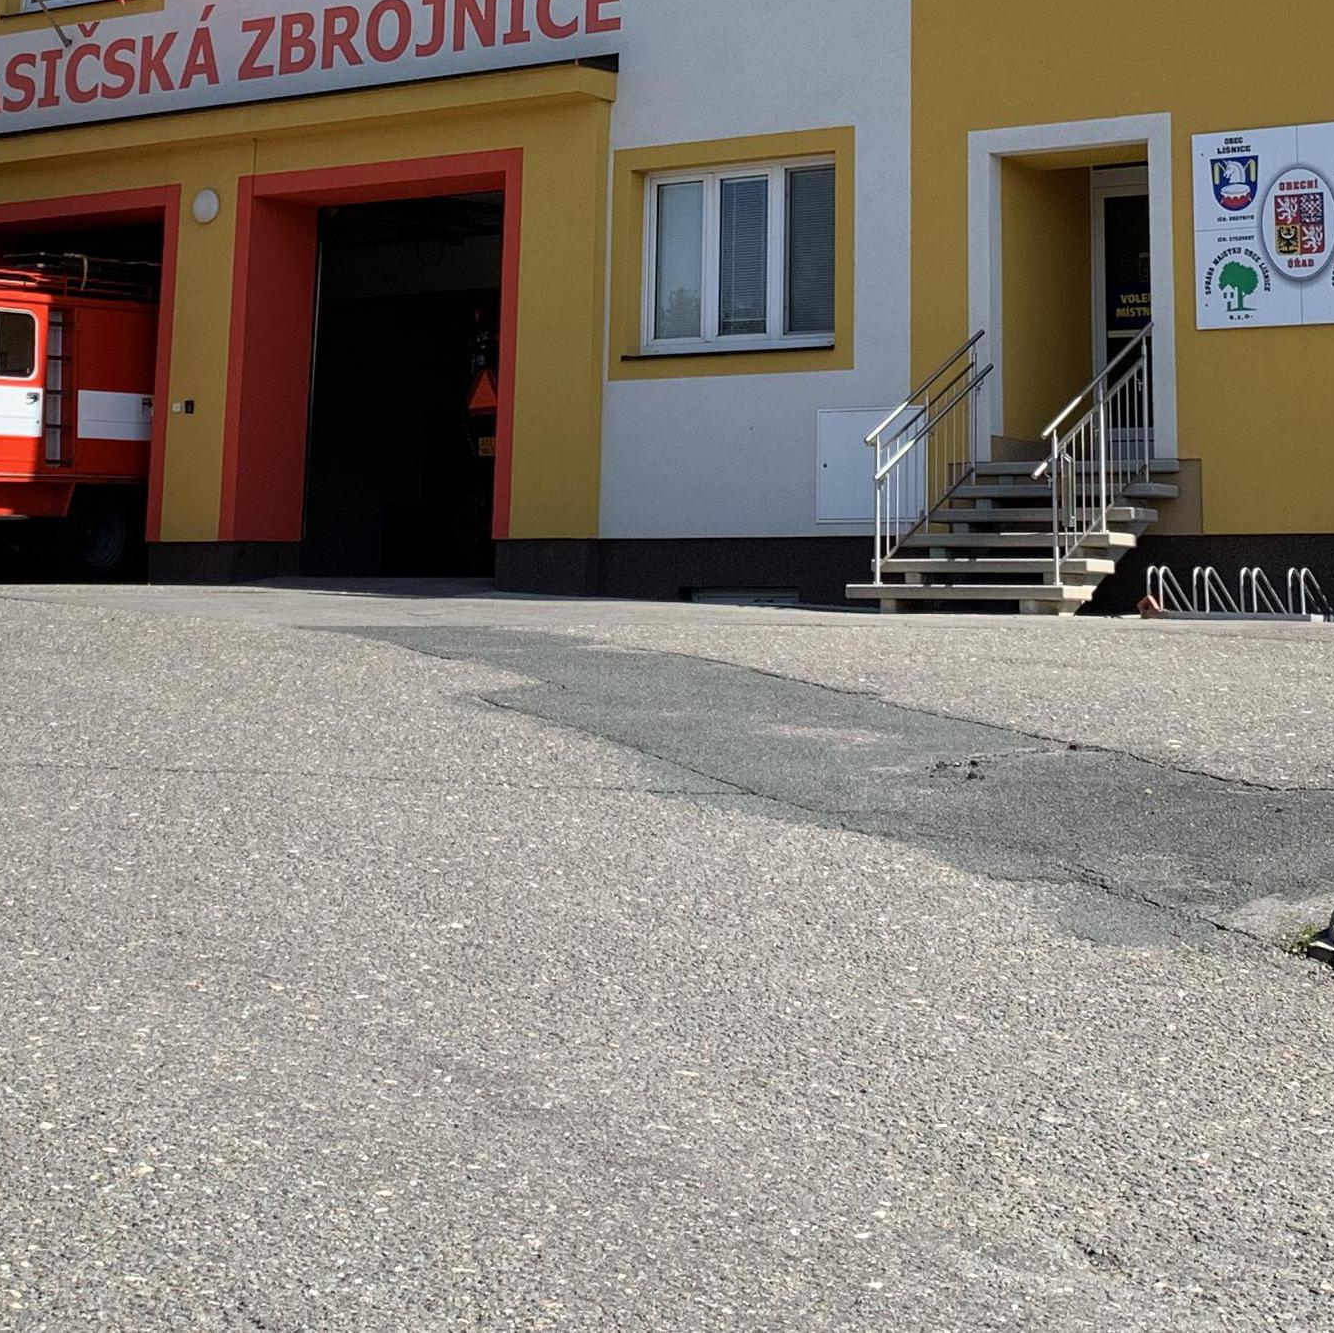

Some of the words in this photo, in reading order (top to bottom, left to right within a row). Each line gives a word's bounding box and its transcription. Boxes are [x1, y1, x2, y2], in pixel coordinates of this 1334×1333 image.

[1224, 137, 1243, 145] OBEC
[1217, 145, 1251, 154] LIŠNICE
[1279, 179, 1318, 191] OBECNÍ
[1288, 258, 1314, 268] ÚŘAD
